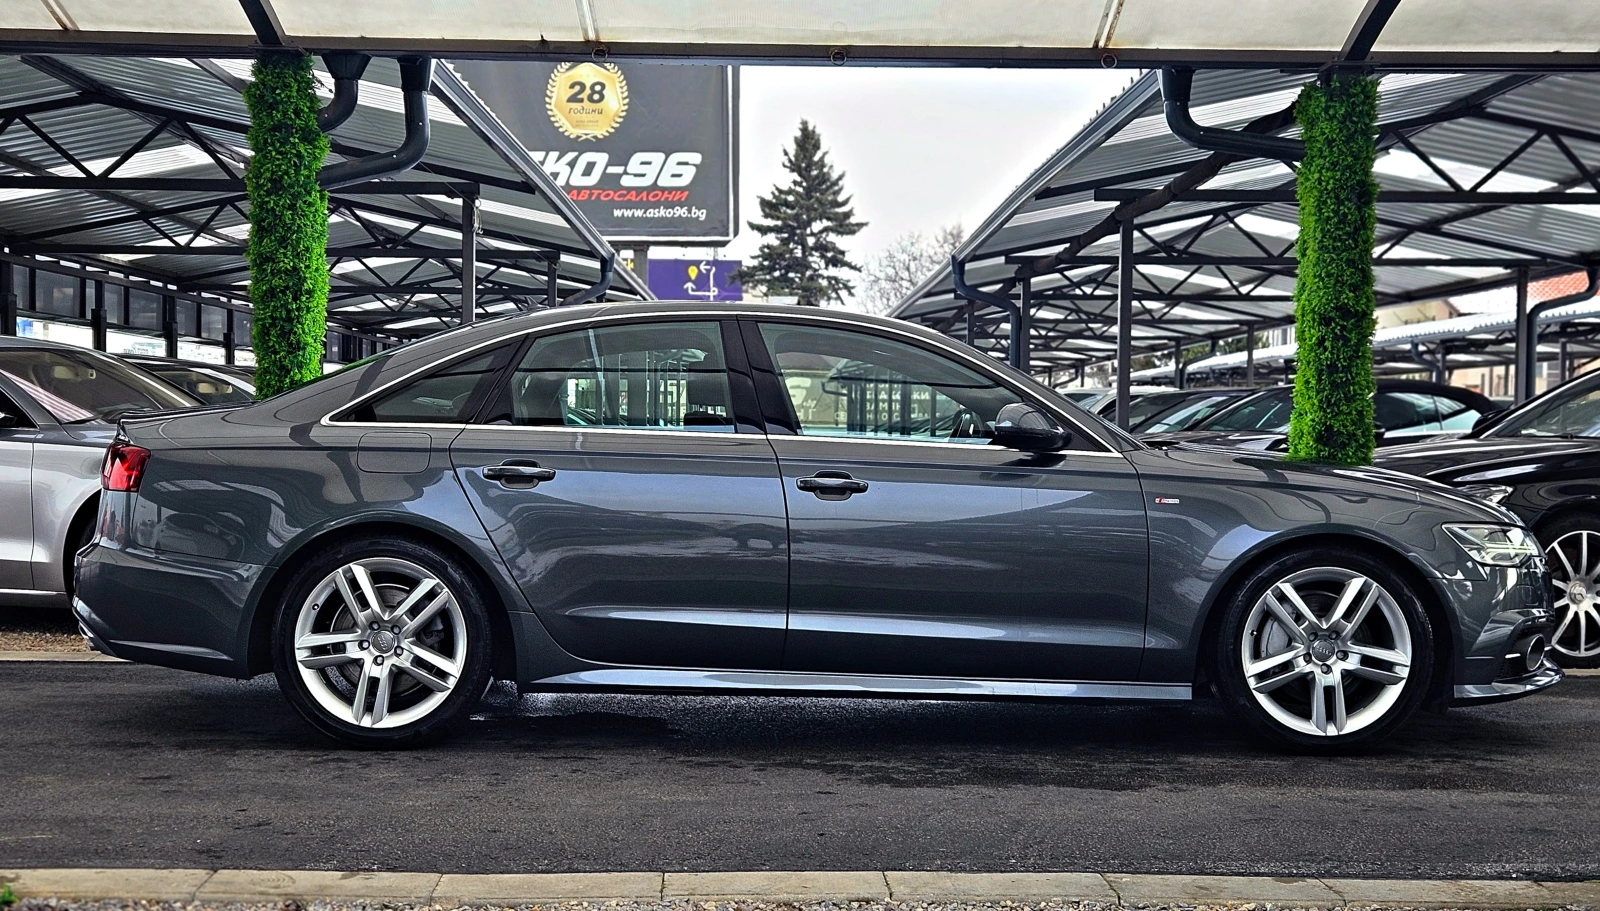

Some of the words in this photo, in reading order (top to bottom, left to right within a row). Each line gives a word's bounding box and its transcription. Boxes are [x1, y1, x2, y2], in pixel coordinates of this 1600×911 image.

[566, 81, 606, 103] 28
[568, 105, 604, 115] години
[568, 189, 689, 202] АВТОСАЛОНИ
[613, 206, 707, 220] www.asko96.bg
